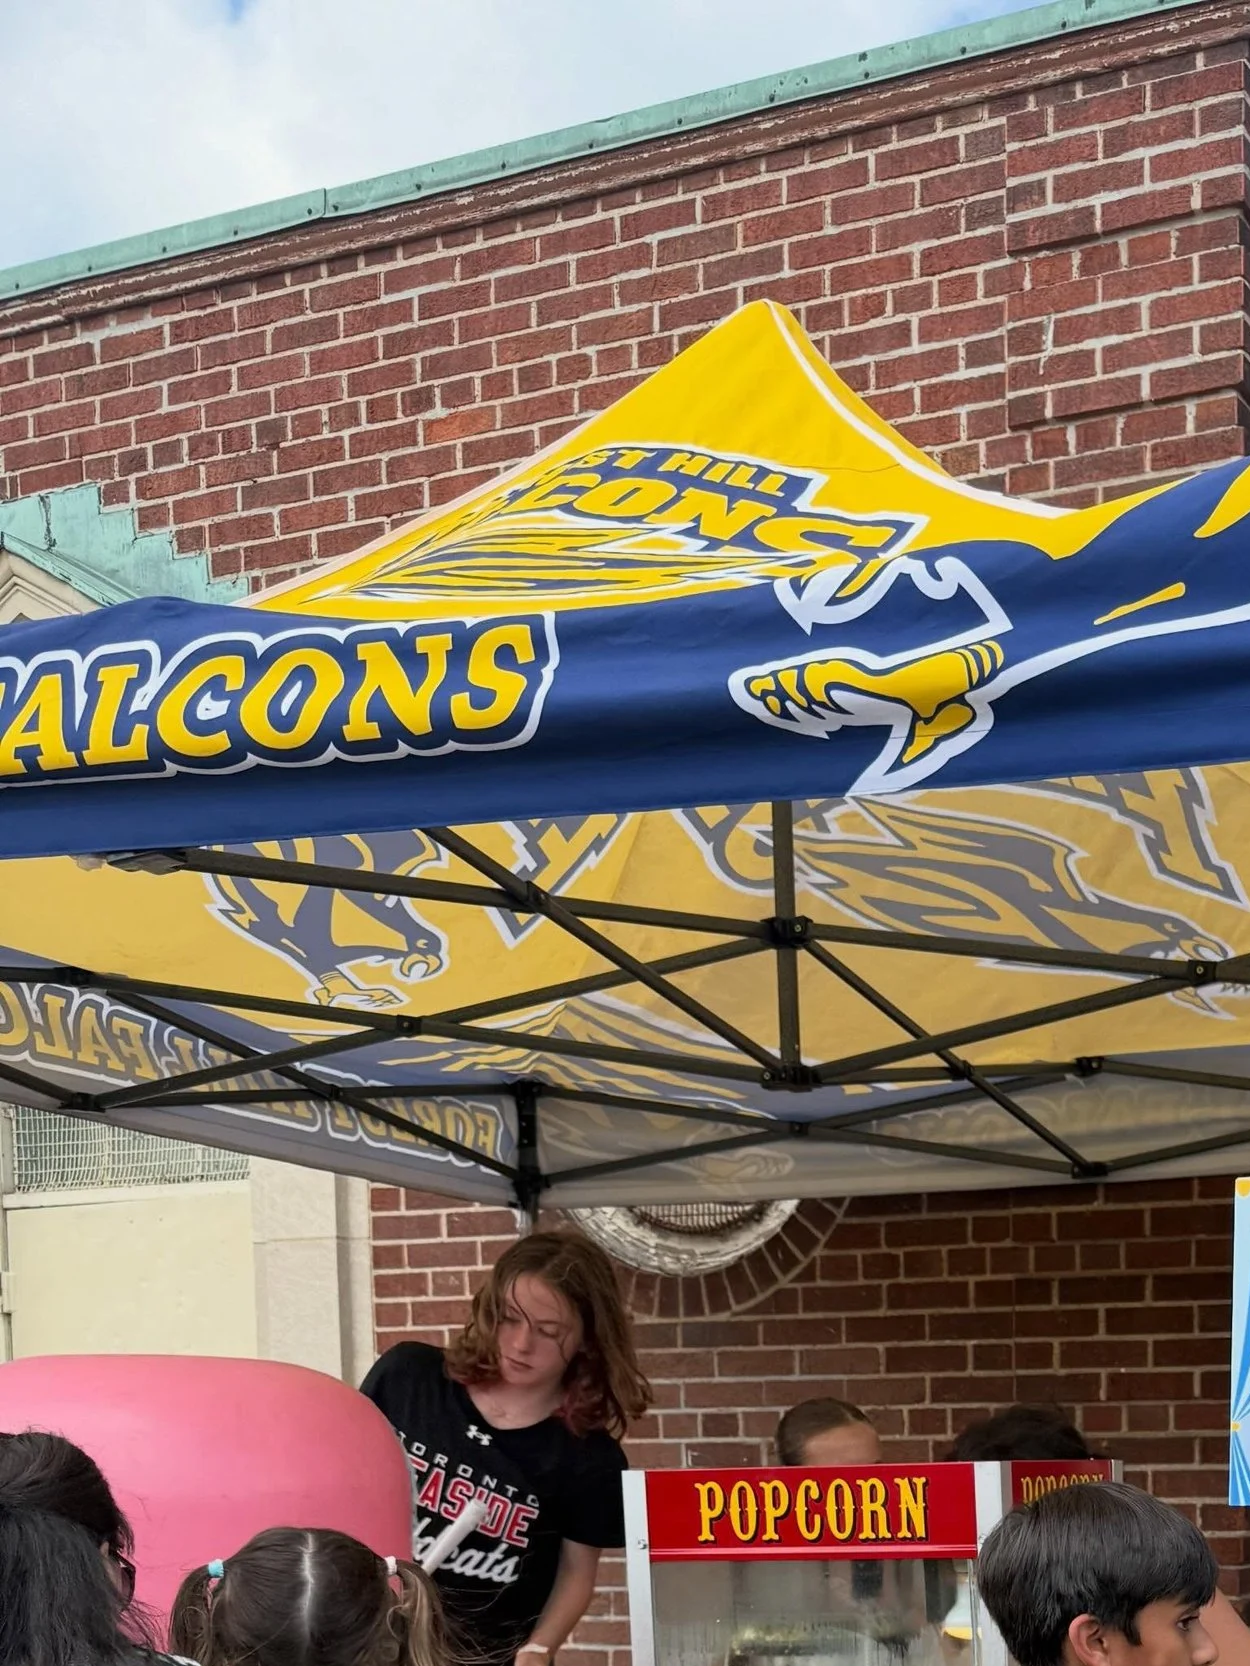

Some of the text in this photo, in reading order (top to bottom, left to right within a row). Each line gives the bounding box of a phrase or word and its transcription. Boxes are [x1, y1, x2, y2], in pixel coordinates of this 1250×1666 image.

[658, 452, 788, 497] HILL
[501, 472, 897, 597] CONS
[0, 624, 537, 776] ALCONS
[397, 1430, 541, 1508] TORONTO
[695, 1477, 929, 1544] POPCORN
